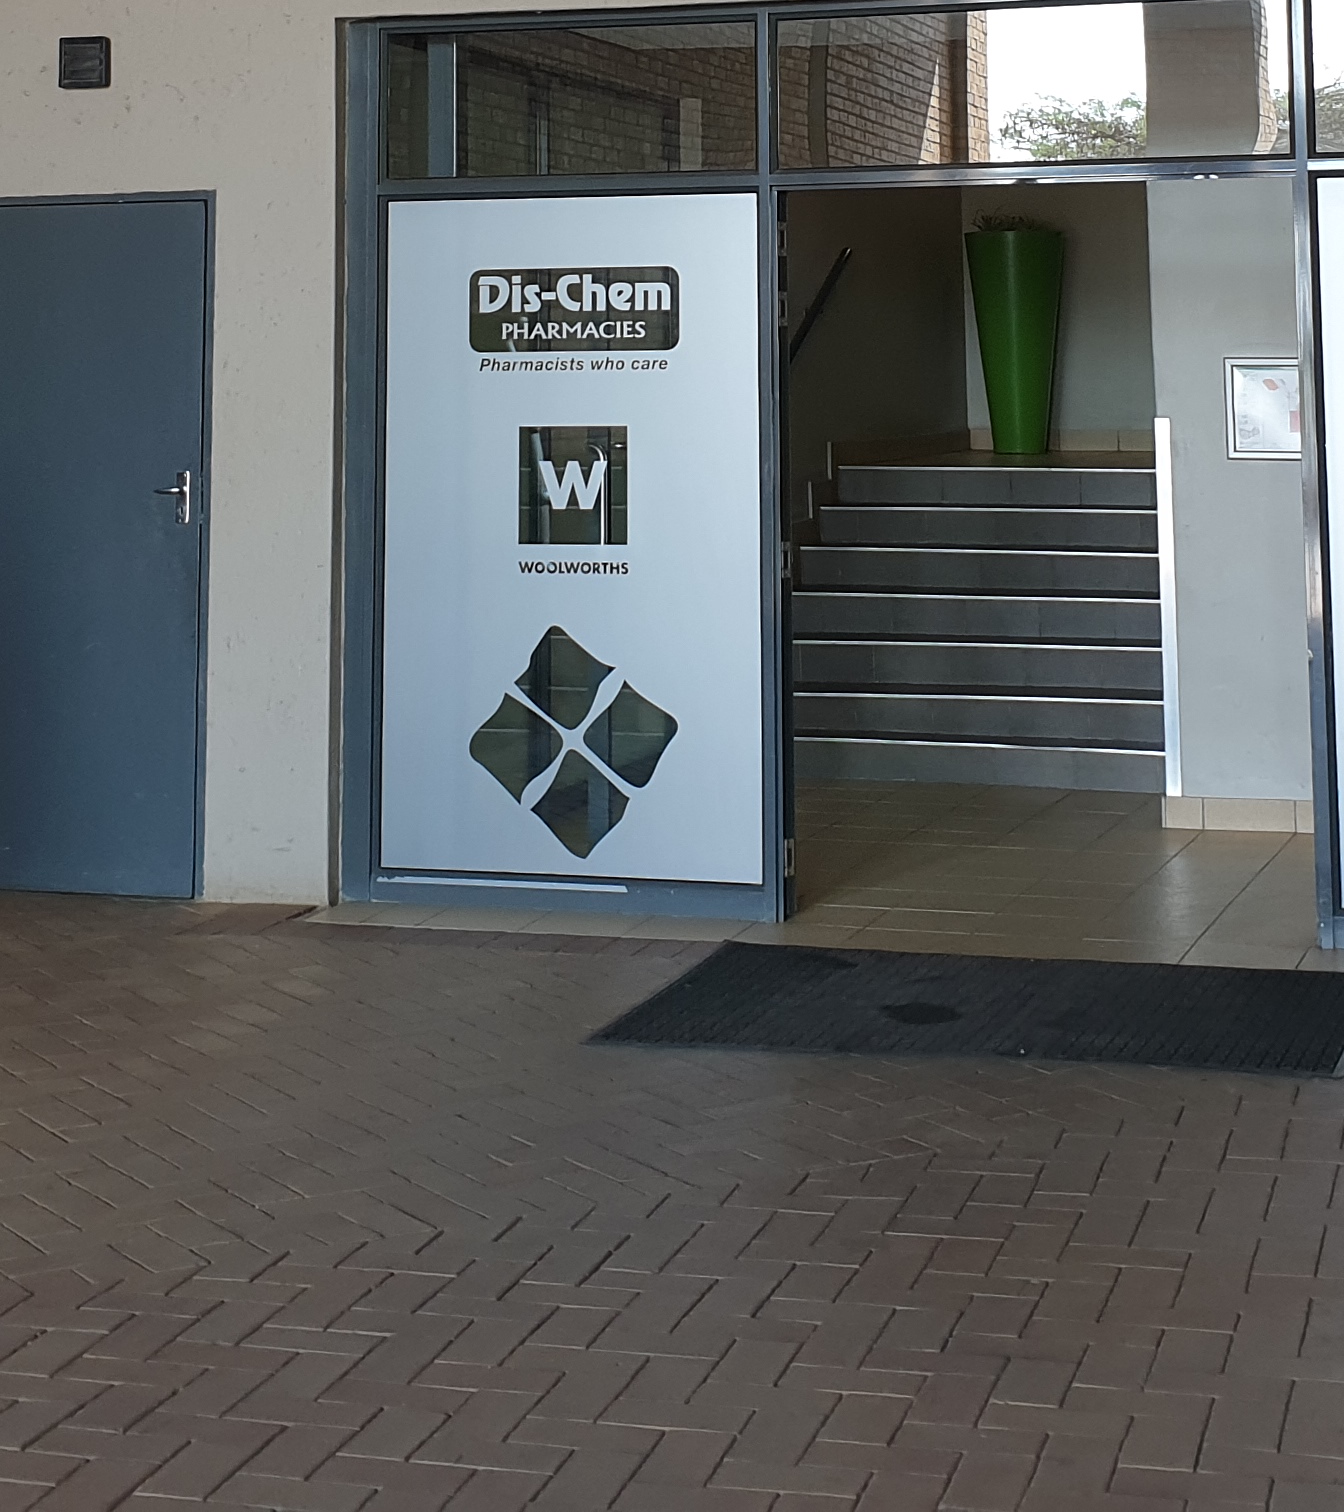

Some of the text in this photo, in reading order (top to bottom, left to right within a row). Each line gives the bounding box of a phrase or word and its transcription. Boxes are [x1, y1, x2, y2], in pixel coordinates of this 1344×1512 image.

[477, 274, 671, 314] Dis-Chem
[501, 321, 646, 340] PHARMACIES
[479, 357, 669, 372] Pharmacists who care
[538, 460, 608, 510] W
[518, 561, 630, 576] WOOLWORTHS
